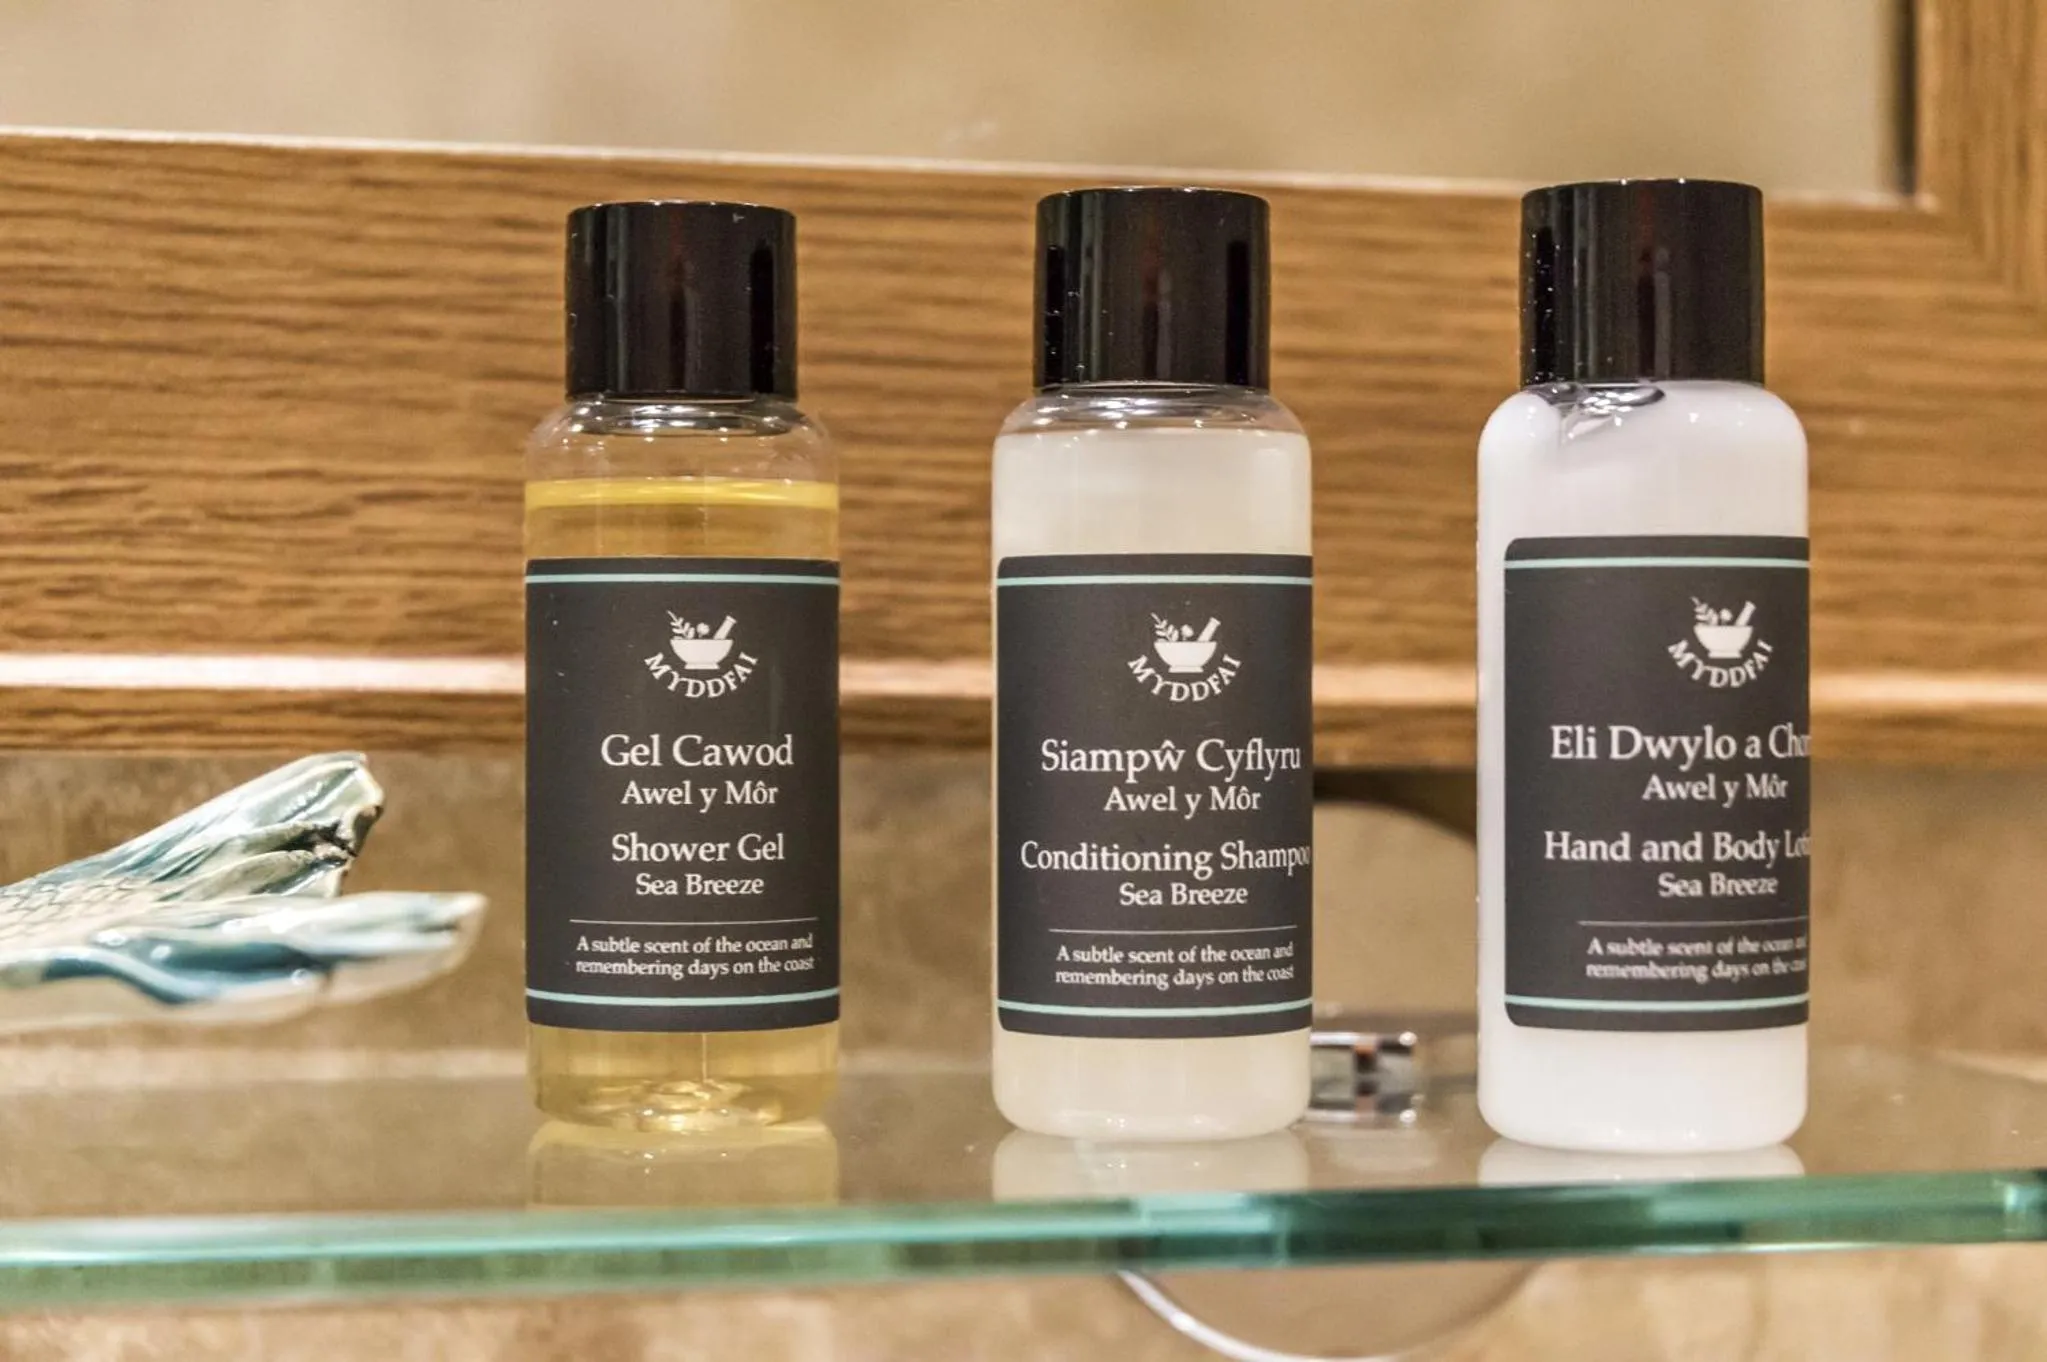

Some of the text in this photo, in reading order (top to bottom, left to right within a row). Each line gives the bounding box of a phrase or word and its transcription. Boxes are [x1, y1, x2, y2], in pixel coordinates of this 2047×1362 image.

[643, 651, 760, 698] MYDDFAI
[1127, 653, 1242, 701] MYDDFAI
[1668, 638, 1773, 688] MYDDFAI
[600, 734, 794, 767] Gel Cawod
[1041, 738, 1301, 783] Siampŵ Cyflyru
[1550, 725, 1598, 760] Eli
[1609, 725, 1737, 772] Dwylo
[1744, 733, 1763, 759] a
[621, 780, 779, 813] Awel y Môr
[1103, 785, 1262, 819] Awel y Môr
[1642, 773, 1789, 808] Awel y Môr
[611, 833, 785, 862] Shower Gel
[1020, 840, 1214, 880] Conditioning
[1544, 831, 1632, 862] Hand
[1640, 831, 1703, 863] and
[1714, 831, 1780, 869] Body
[635, 874, 765, 895] Sea Breeze
[1119, 883, 1249, 906] Sea Breeze
[1657, 872, 1779, 897] Sea Breeze
[576, 933, 814, 954] A subtle scent of the ocean and
[1056, 942, 1295, 964] A subtle scent of the ocean and
[575, 956, 815, 981] remembering days on the coast
[1054, 964, 1295, 991] remembering days on the coast
